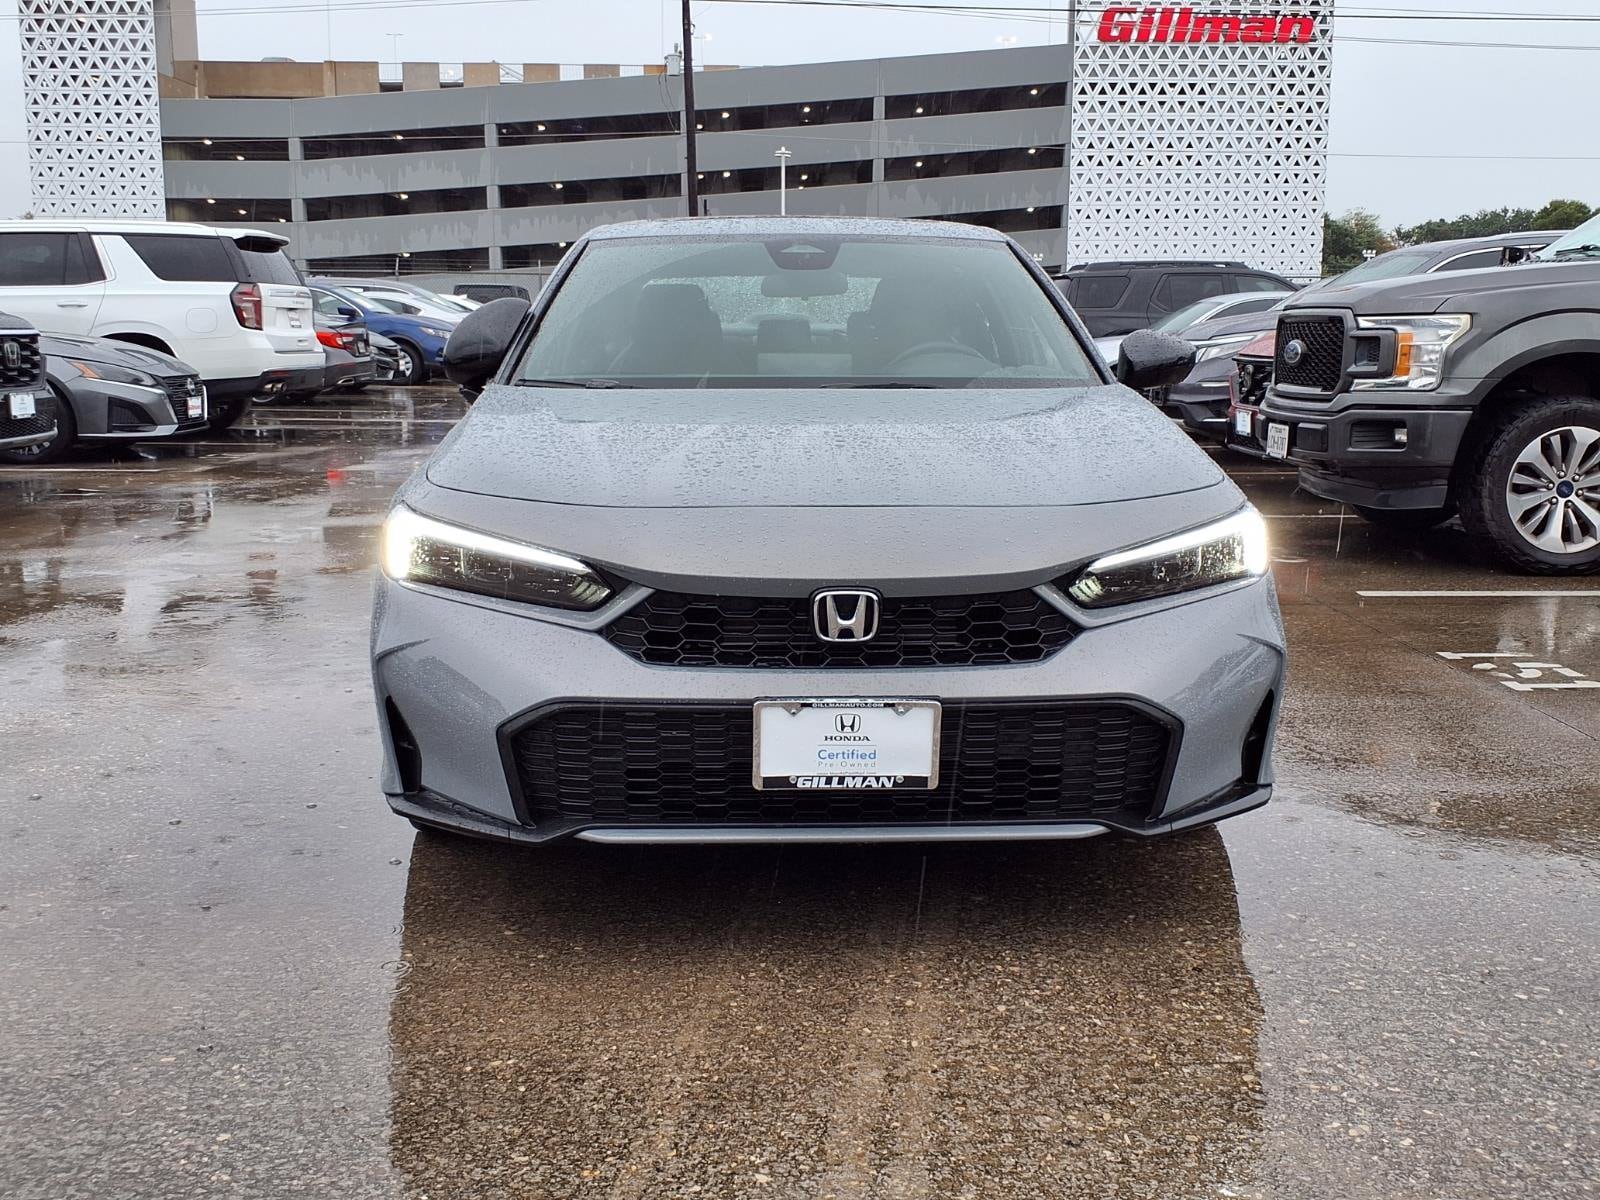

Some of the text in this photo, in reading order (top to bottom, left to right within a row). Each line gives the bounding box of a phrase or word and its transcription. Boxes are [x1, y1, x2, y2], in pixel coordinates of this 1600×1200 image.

[1098, 7, 1314, 43] Gillman
[818, 749, 877, 760] Certified
[797, 776, 895, 788] GILLMAN
